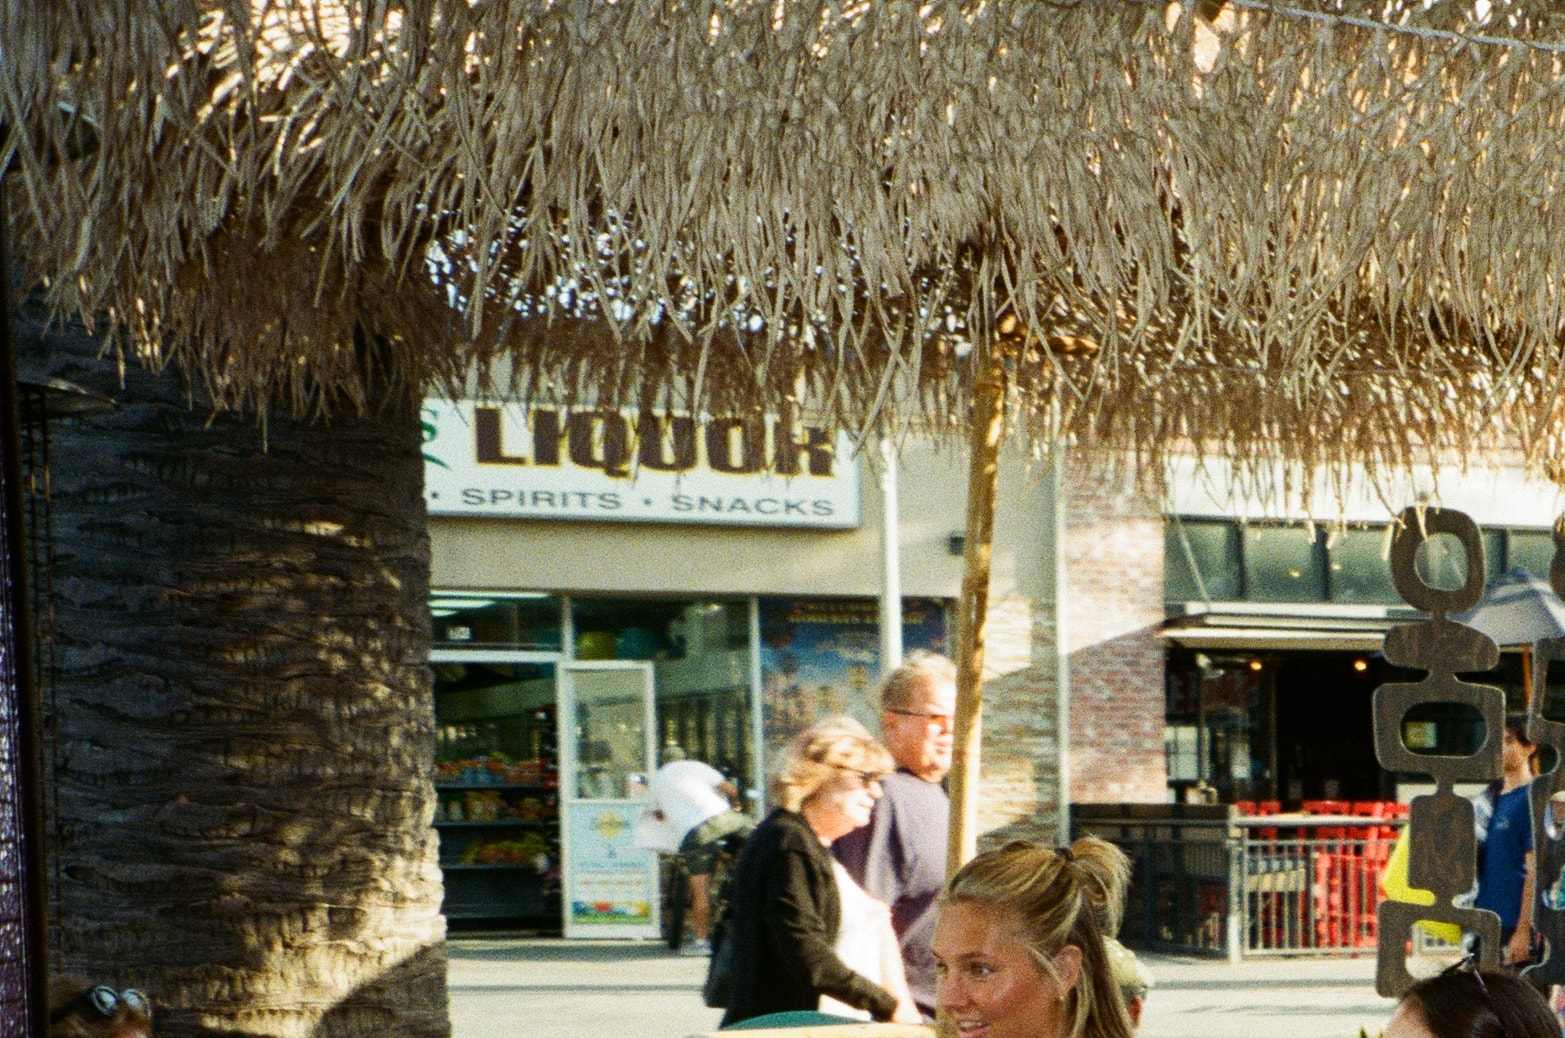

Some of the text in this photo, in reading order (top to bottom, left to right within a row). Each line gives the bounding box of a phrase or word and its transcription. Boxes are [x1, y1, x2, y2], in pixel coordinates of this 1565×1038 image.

[474, 404, 835, 480] LIQUOR
[462, 487, 834, 516] SPIRITS SNACKS
